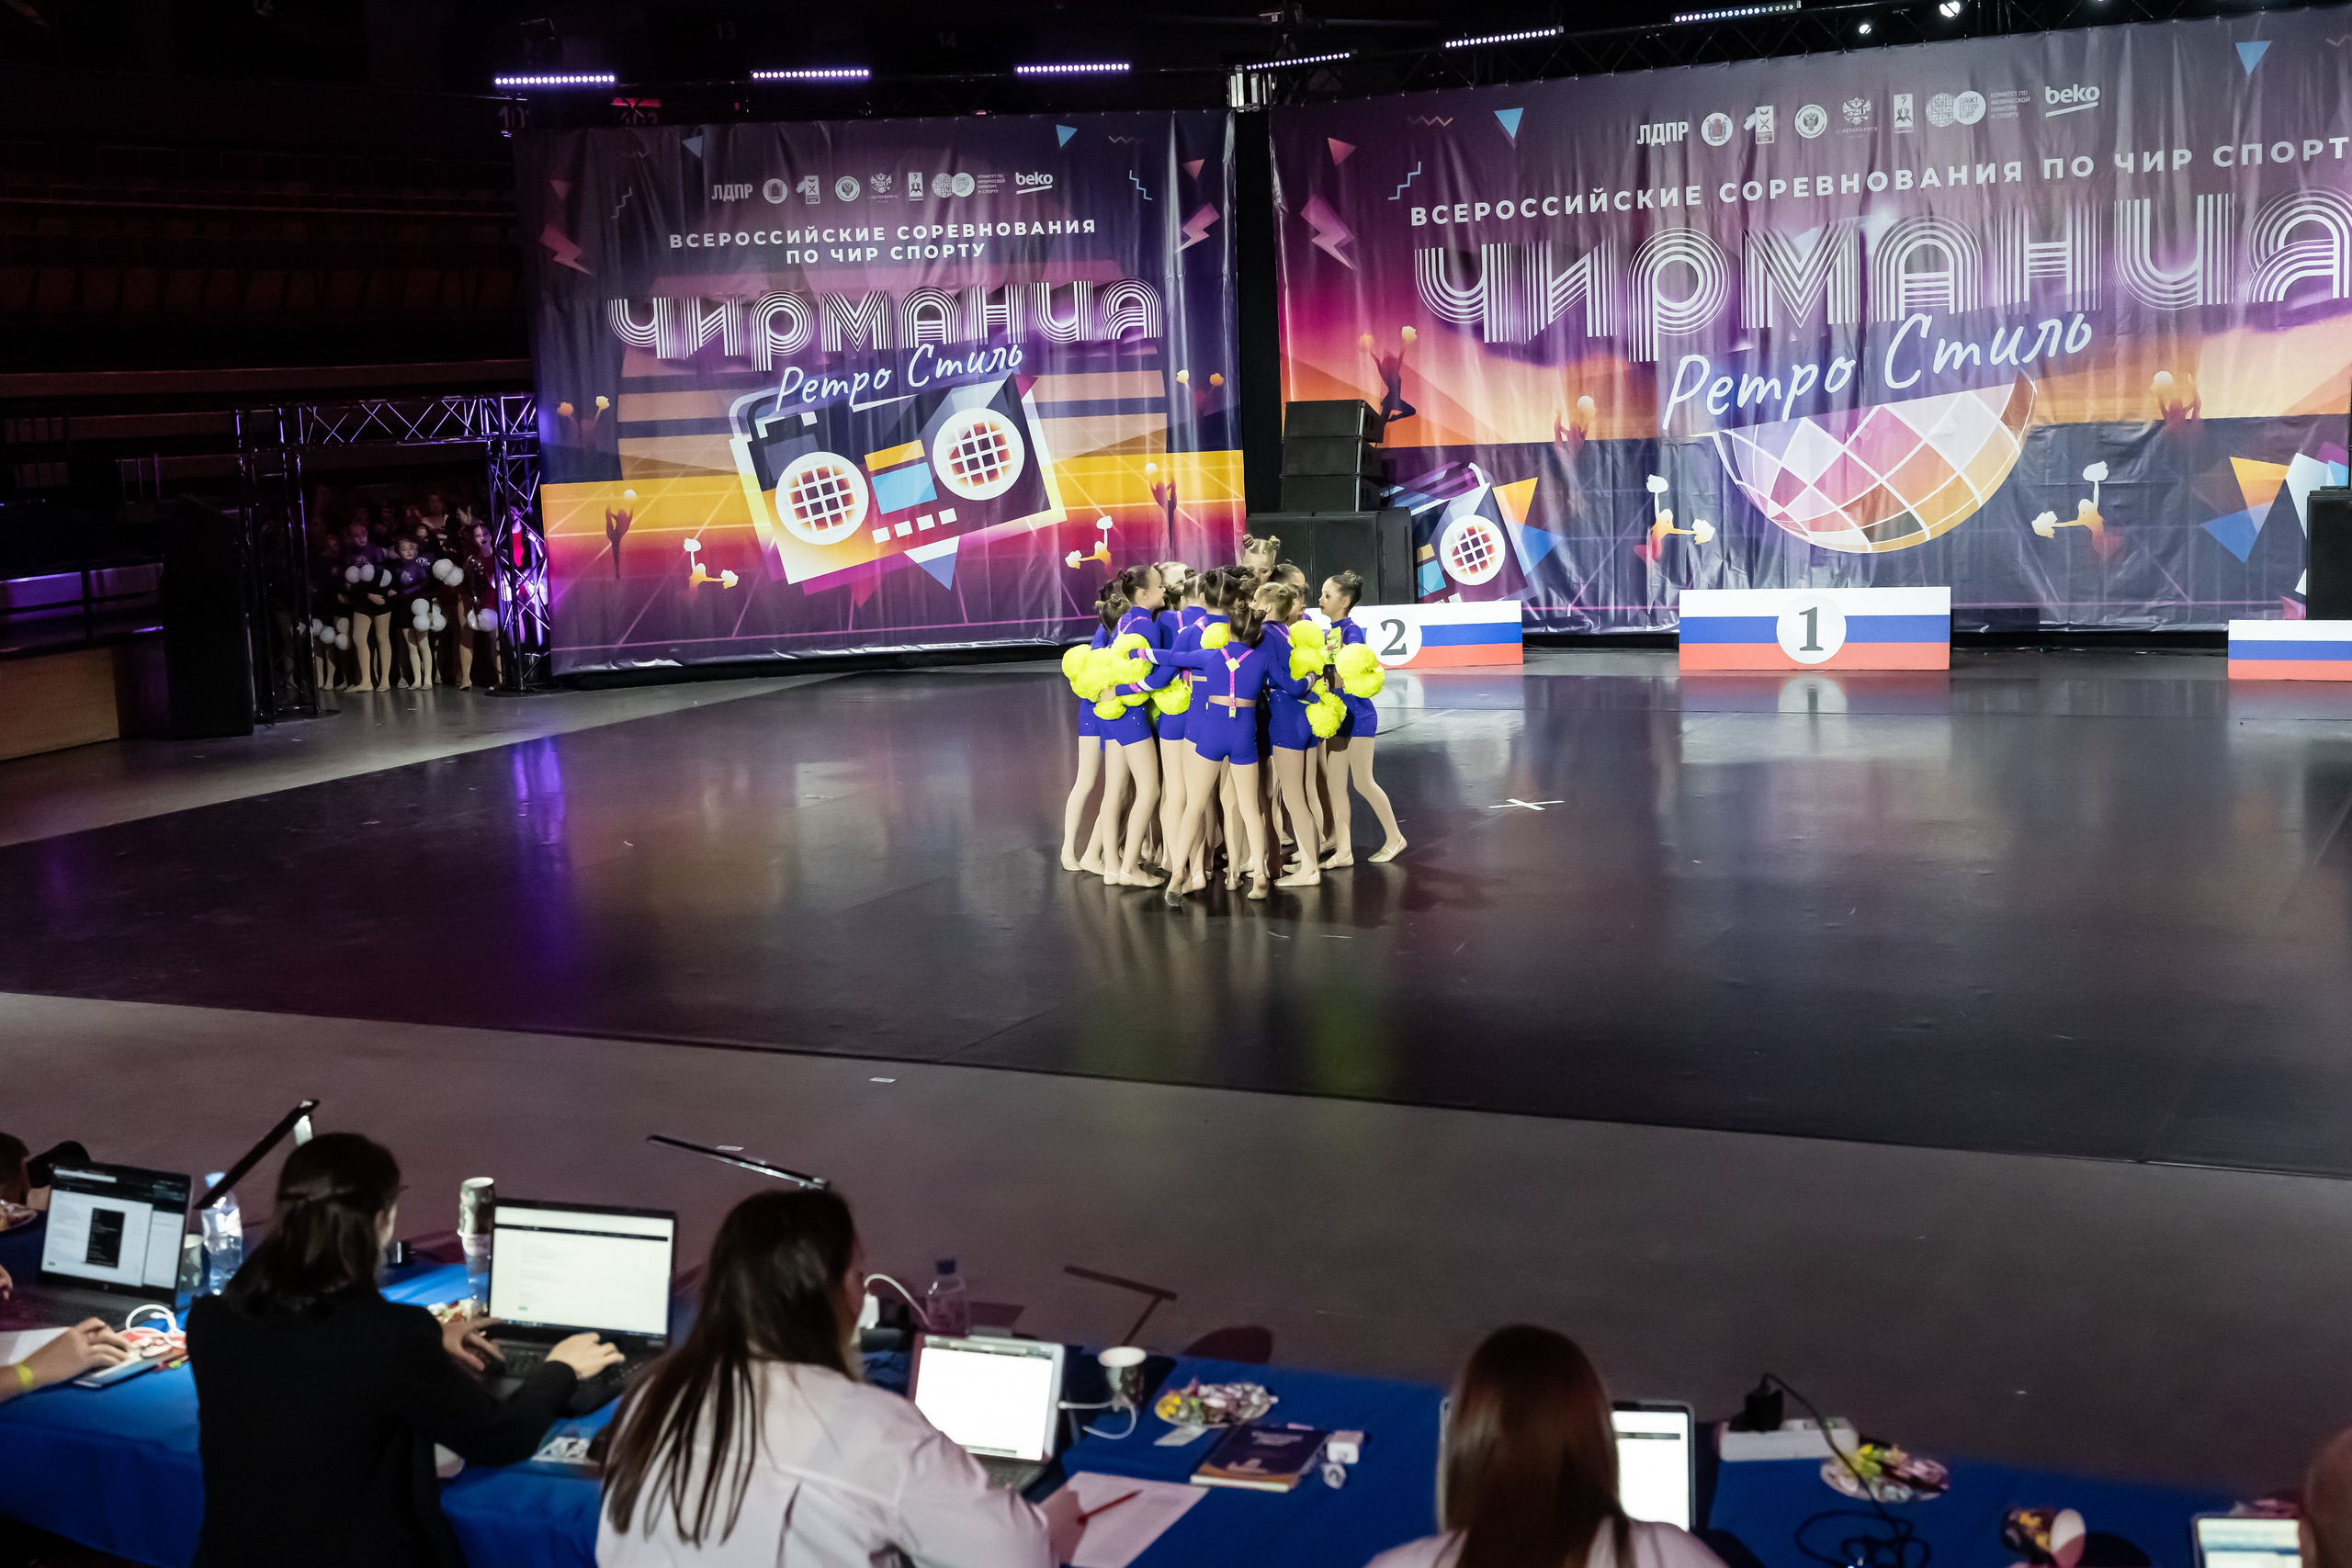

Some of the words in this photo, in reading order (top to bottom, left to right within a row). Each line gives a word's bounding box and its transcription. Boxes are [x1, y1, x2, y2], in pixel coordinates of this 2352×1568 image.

[1990, 90, 2018, 98] КОМИТЕТ
[1990, 96, 2030, 106] ФИЗИЧЕСКОЙ
[2045, 84, 2100, 105] beko
[1996, 111, 2020, 119] СПОРТУ
[1636, 121, 1690, 146] ЛДПР
[1015, 171, 1054, 186] beko
[1410, 185, 1702, 227] ВСЕРОССИЙСКИЕ
[1718, 161, 2022, 202] СОРЕВНОВАНИЯ
[2042, 154, 2095, 180] ПО
[2114, 148, 2193, 173] ЧИР
[711, 184, 753, 201] ЛДПР
[669, 225, 886, 249] ВСЕРОССИЙСКИЕ
[897, 219, 1096, 241] СОРЕВНОВАНИЯ
[786, 249, 820, 265] ПО
[830, 247, 879, 263] ЧИР
[889, 243, 986, 261] СПОРТУ
[775, 366, 892, 412] Ретро
[907, 343, 1023, 389] Стиль
[1662, 353, 1857, 430] Ретро
[1883, 312, 2093, 390] Стиль
[1380, 618, 1408, 656] 2
[1798, 606, 1825, 651] 1
